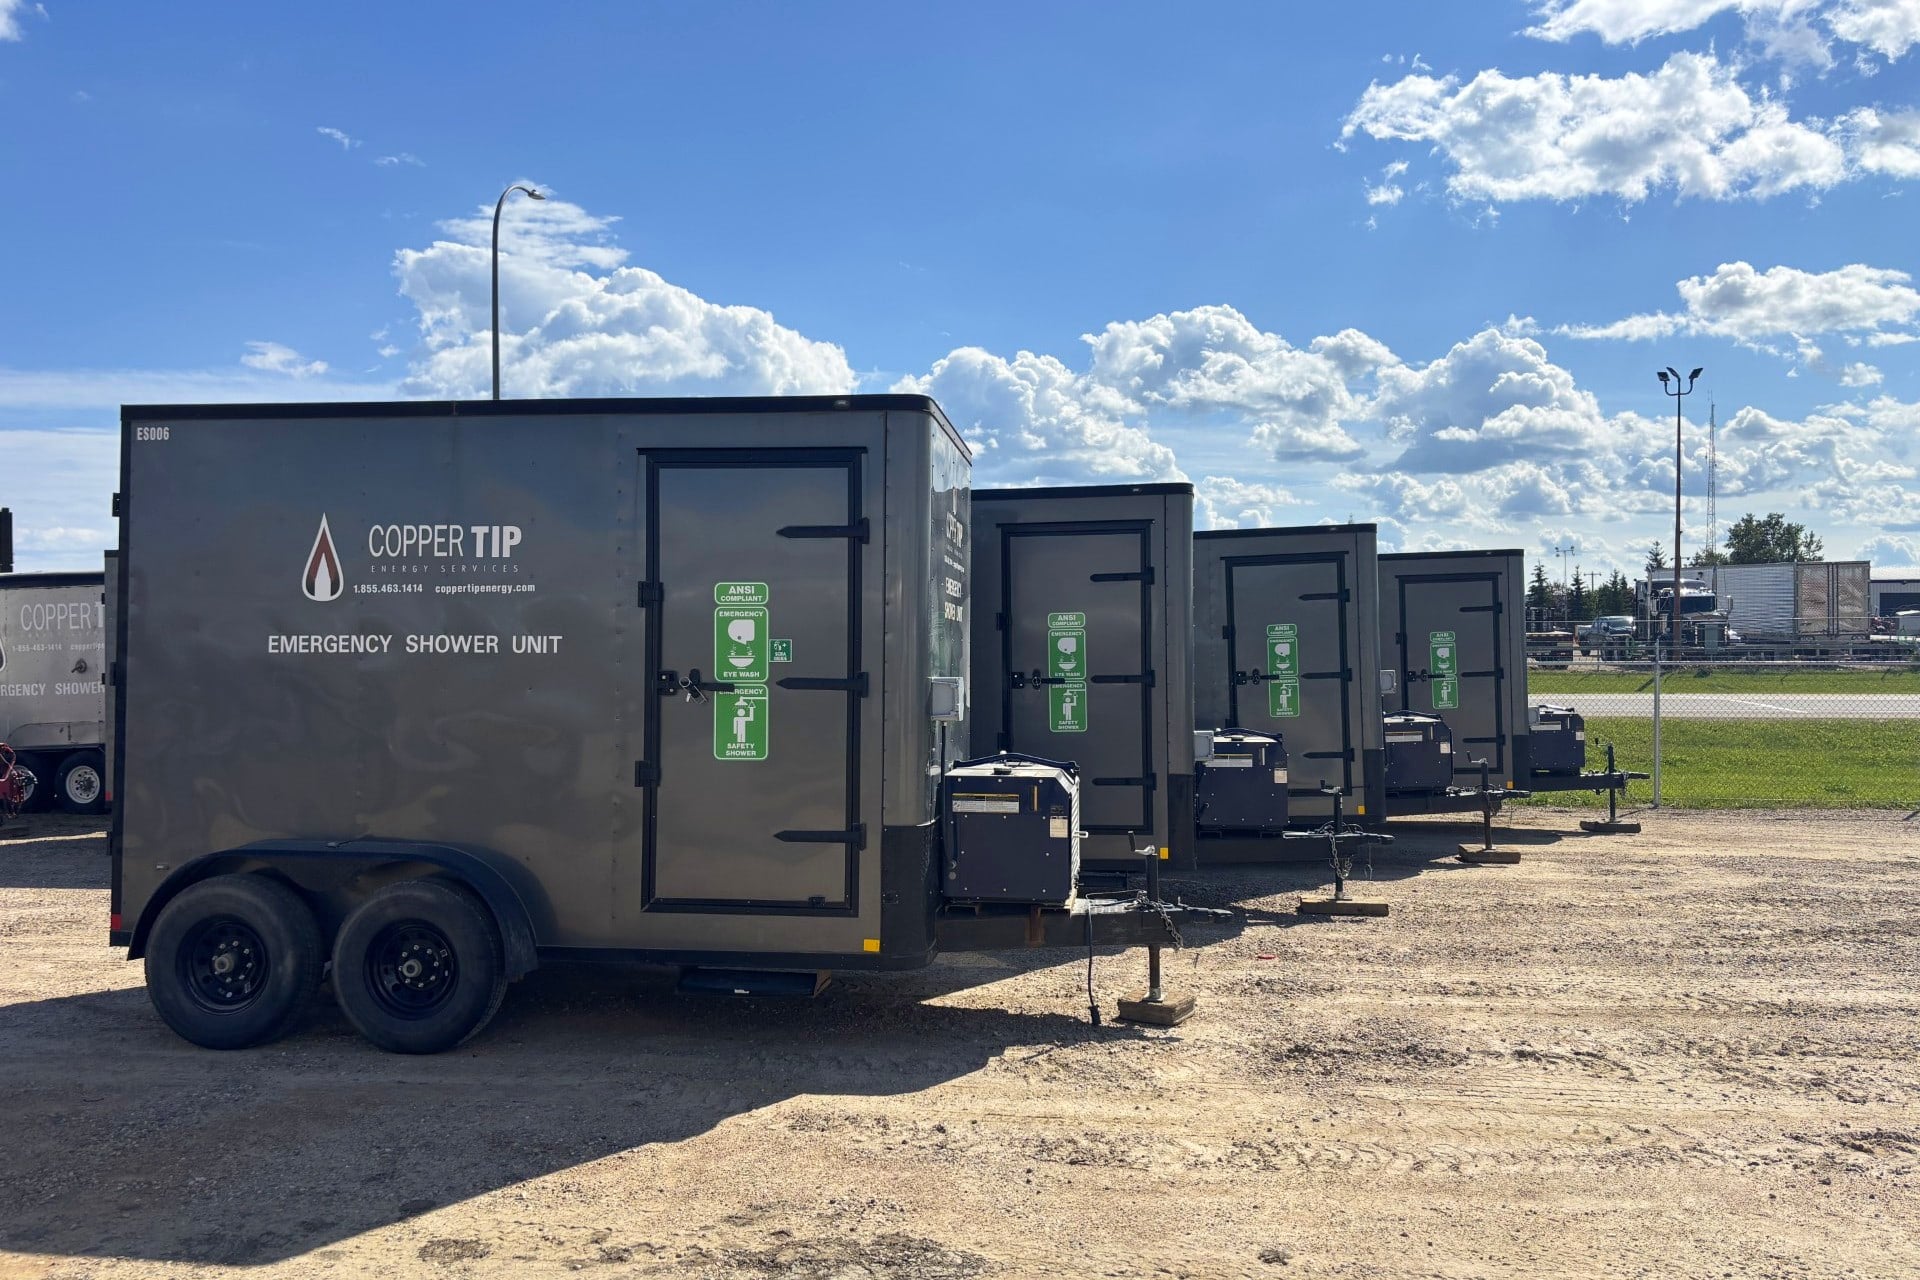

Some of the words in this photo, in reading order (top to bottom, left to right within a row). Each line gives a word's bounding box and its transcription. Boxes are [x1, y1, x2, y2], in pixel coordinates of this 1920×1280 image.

[137, 427, 170, 441] ES006
[368, 524, 464, 558] COPPER
[471, 525, 522, 558] TIP
[371, 564, 429, 573] ENERGY
[440, 564, 519, 573] SERVICES
[353, 584, 423, 594] 1.855.463.1414
[435, 583, 536, 595] coppertipenergy.com
[729, 585, 755, 594] ANSI
[21, 602, 91, 631] COPPER
[268, 634, 393, 653] EMERGENCY
[405, 634, 499, 653] SHOWER
[512, 635, 563, 654] UNIT
